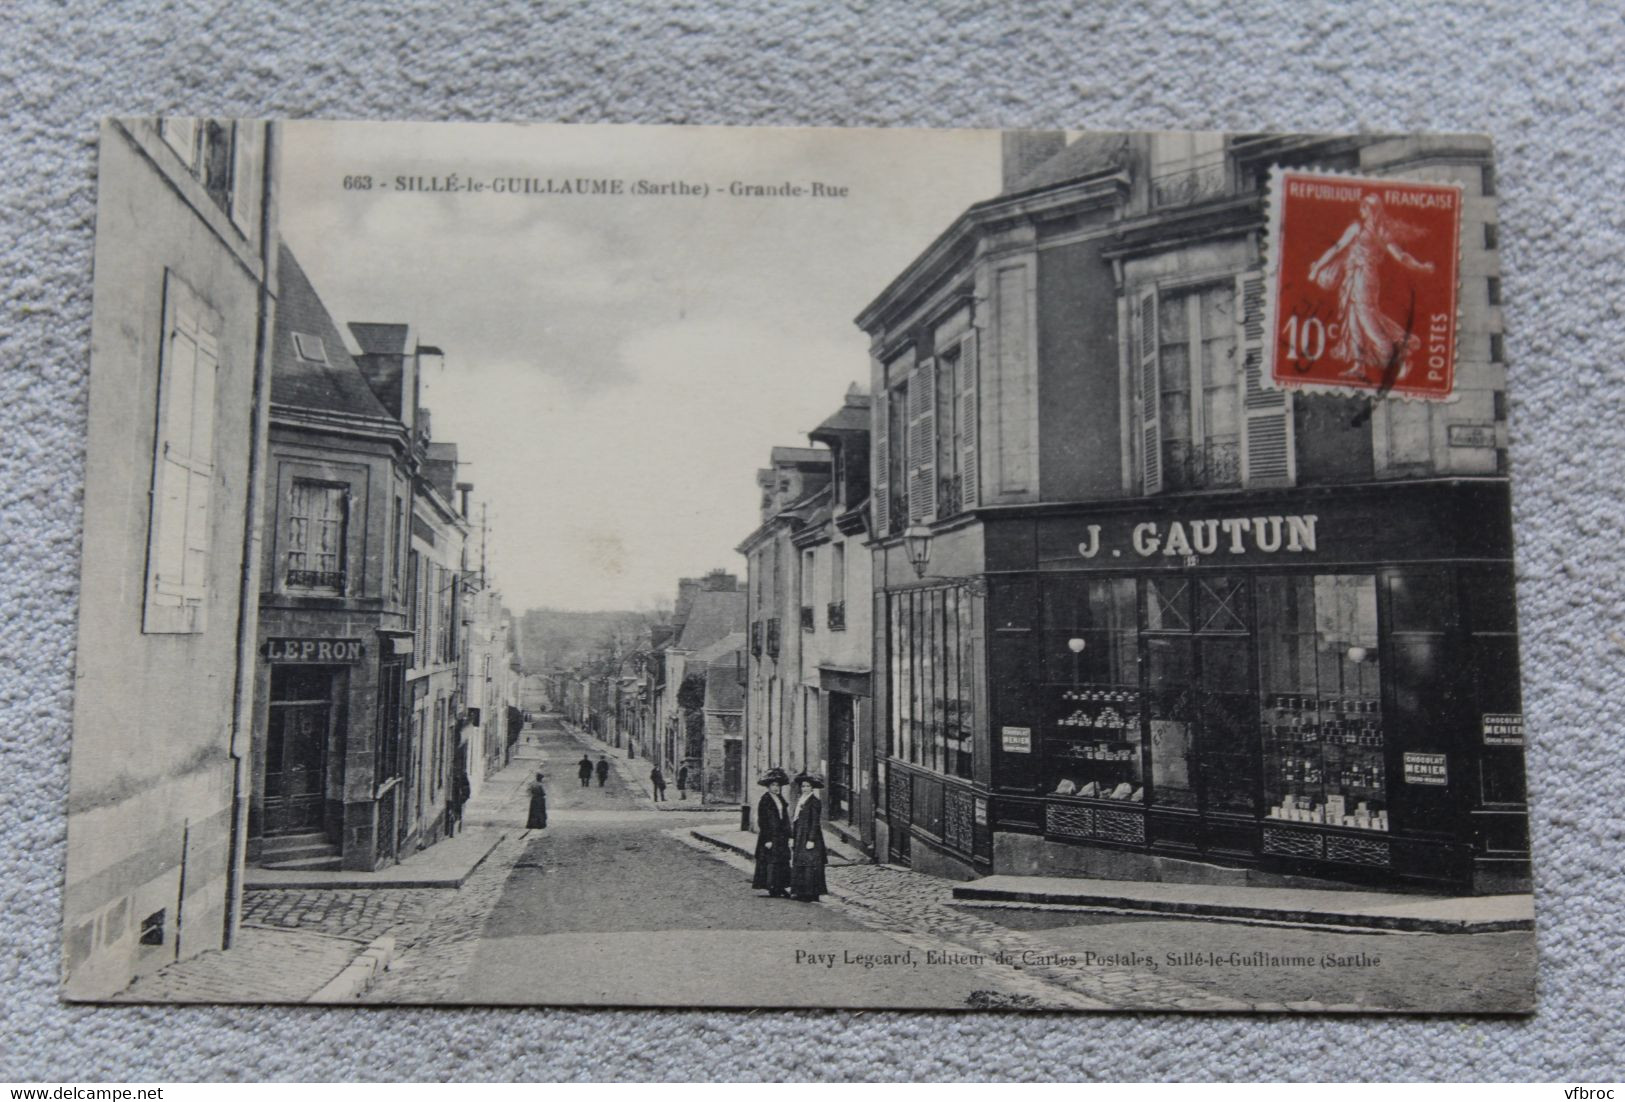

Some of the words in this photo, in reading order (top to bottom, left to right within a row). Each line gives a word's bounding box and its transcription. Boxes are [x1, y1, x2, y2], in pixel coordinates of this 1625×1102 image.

[343, 175, 373, 191] 663
[394, 173, 624, 195] SILLÉ-le-GUILLAUME
[630, 179, 710, 199] (Sarthe)
[729, 181, 850, 198] Grande-Rue
[1289, 181, 1363, 202] REPUBLIQUE
[1384, 189, 1454, 209] FRANÇAISE
[1427, 312, 1448, 382] POSTES
[1132, 514, 1318, 557] GAUTUN
[268, 640, 361, 660] LEPRON
[1405, 763, 1446, 775] MENIER
[795, 949, 836, 968] Pavy
[994, 950, 1014, 966] de
[1022, 950, 1077, 966] Cartes
[1085, 951, 1159, 970] Postales,
[1166, 951, 1315, 968] Sillé-le-Guillaume
